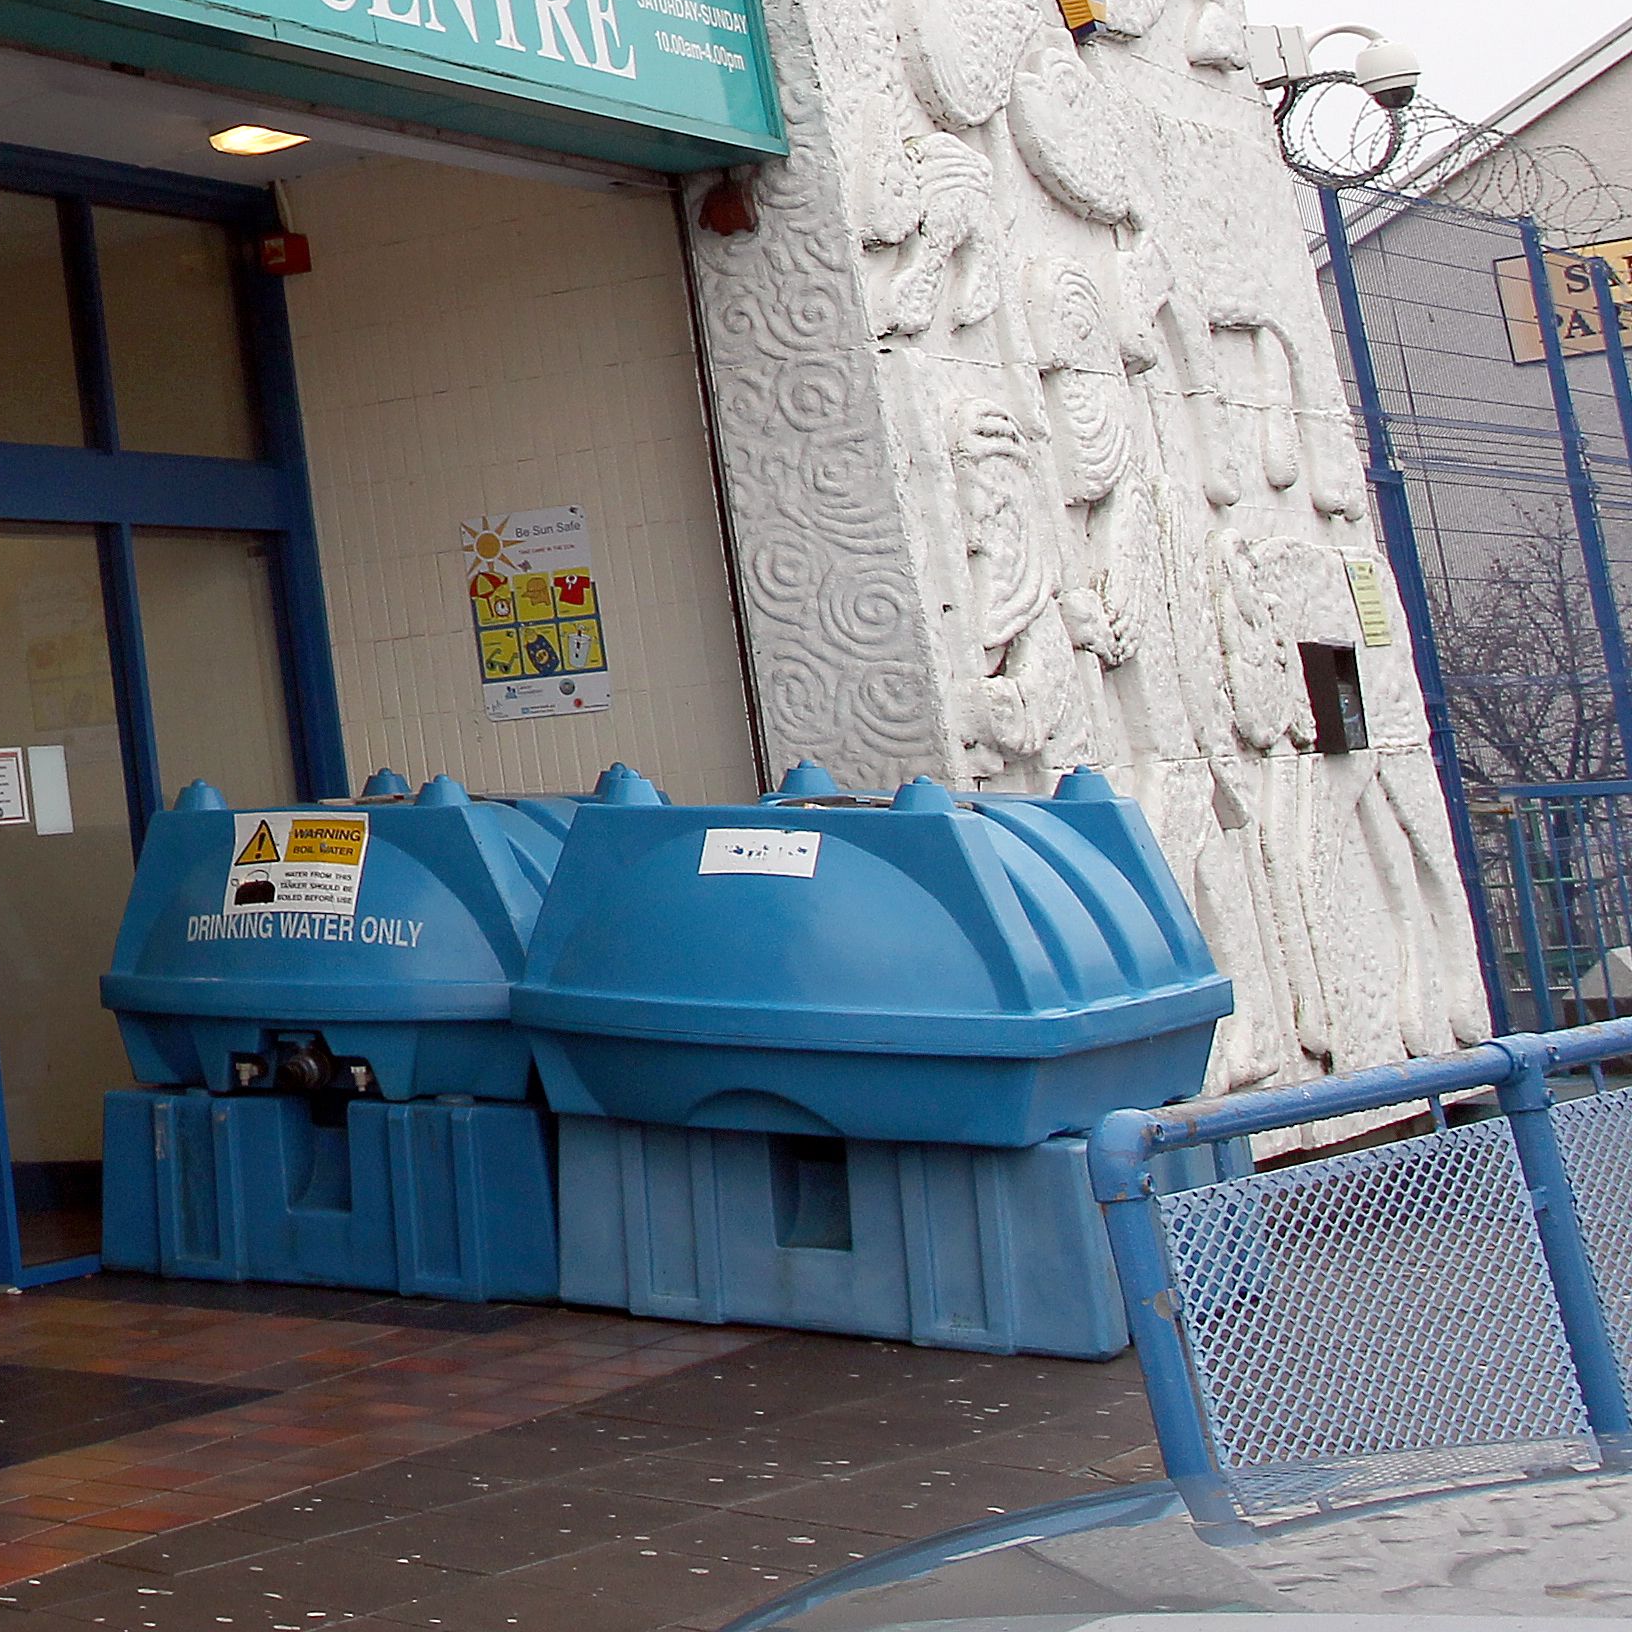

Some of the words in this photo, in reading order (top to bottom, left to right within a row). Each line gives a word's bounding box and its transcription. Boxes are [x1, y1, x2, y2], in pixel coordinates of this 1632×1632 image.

[654, 30, 746, 73] 10.00am-4.00pm
[516, 528, 529, 537] Be
[533, 525, 553, 536] Sun
[556, 521, 581, 532] Safe
[294, 828, 361, 842] WARNING
[293, 846, 315, 854] BOIL
[320, 845, 353, 855] WATER
[310, 871, 332, 879] FROM
[335, 872, 352, 880] THIS
[187, 912, 273, 942] DRINKING
[279, 913, 354, 942] WATER
[360, 916, 424, 948] ONLY
